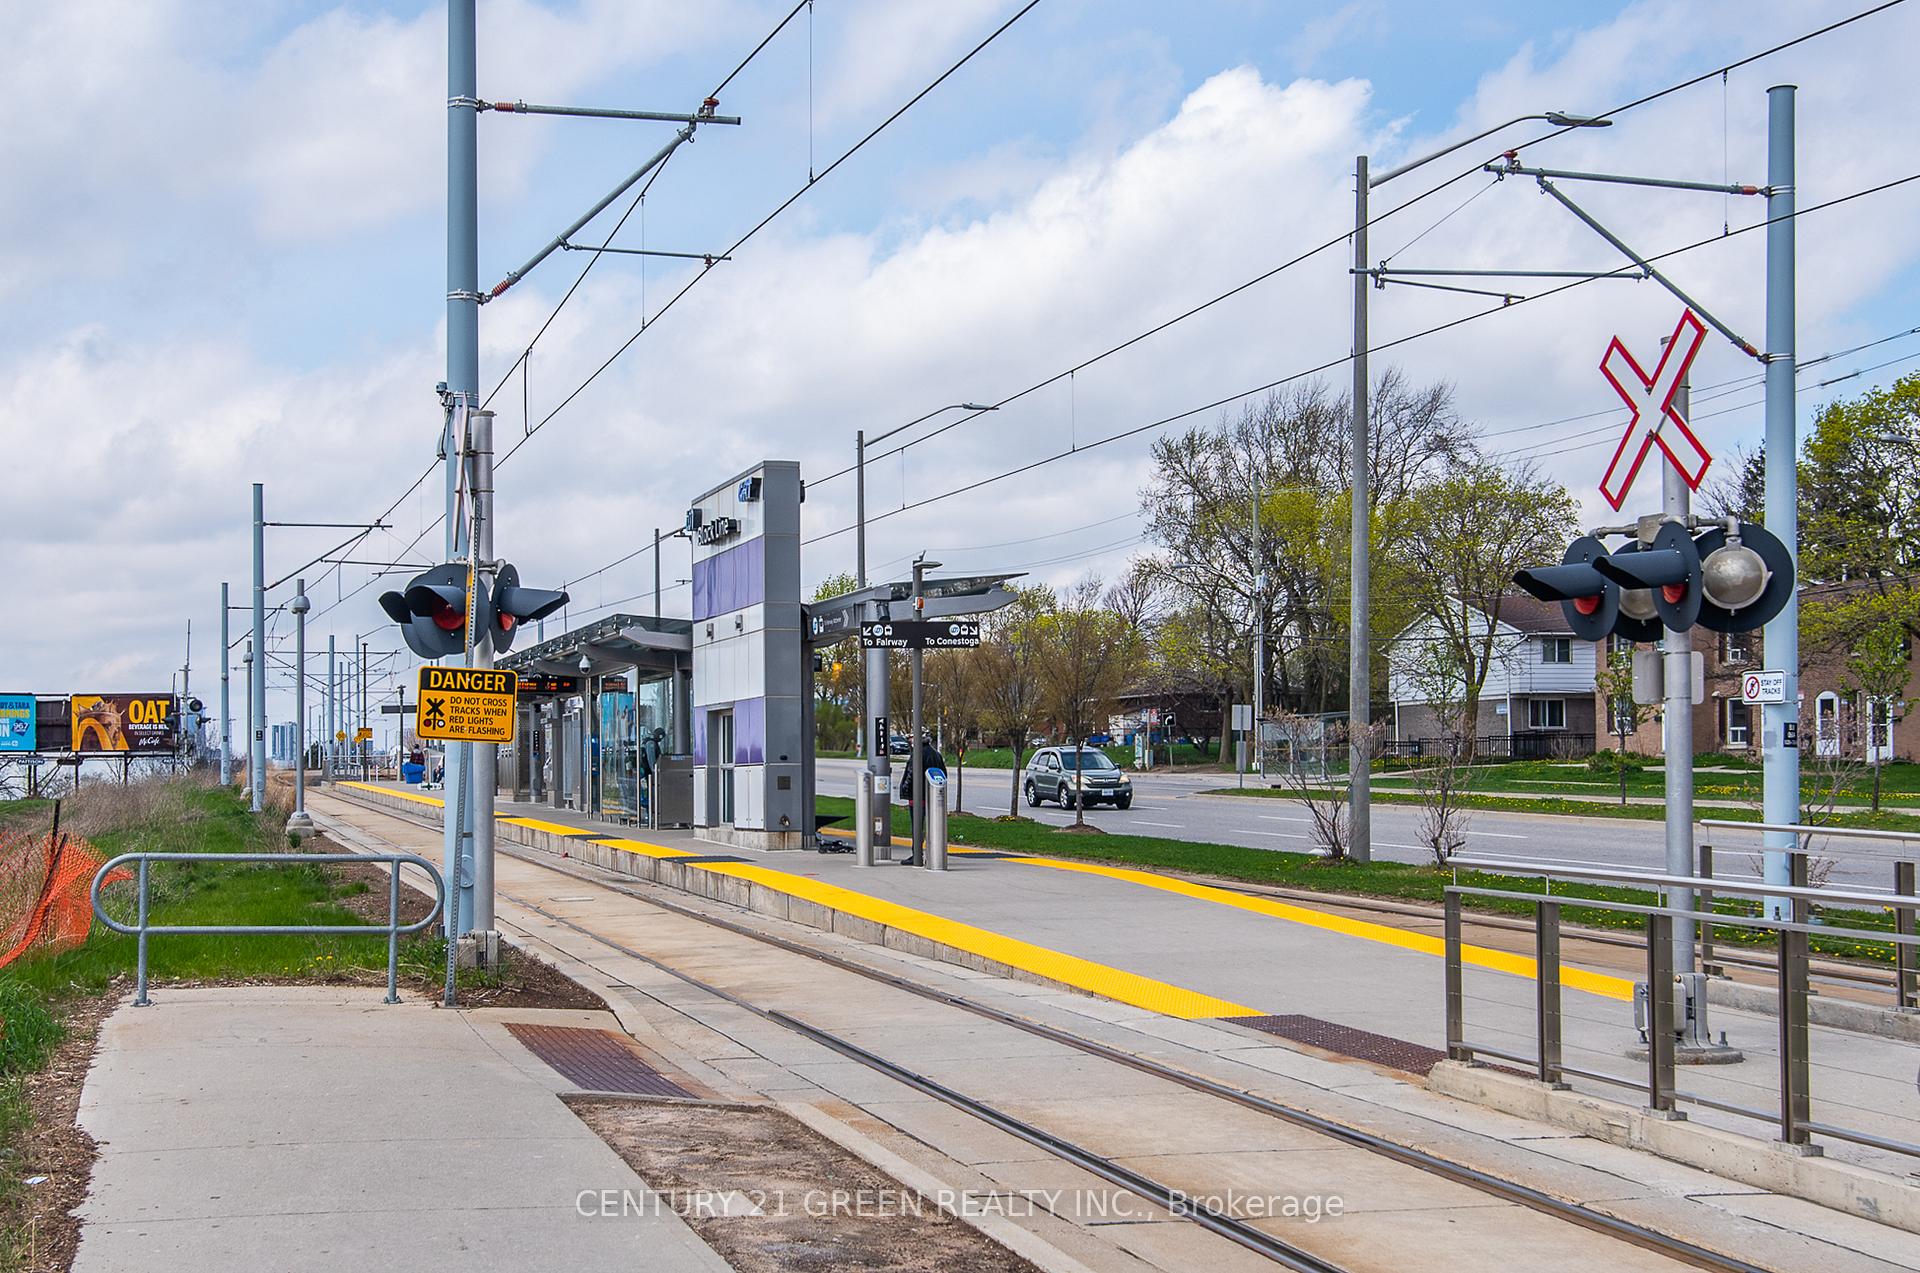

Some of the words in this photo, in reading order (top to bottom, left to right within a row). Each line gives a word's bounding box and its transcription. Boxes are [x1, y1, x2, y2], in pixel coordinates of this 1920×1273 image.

[876, 638, 908, 648] Fairway
[925, 637, 935, 646] To
[936, 637, 980, 647] Conestoga
[429, 670, 507, 692] DANGER
[1760, 679, 1772, 687] STAY
[1773, 678, 1783, 686] OFF
[1762, 687, 1781, 695] TRACKS
[450, 696, 462, 704] DO
[464, 697, 480, 706] NOT
[482, 698, 508, 707] CROSS
[128, 699, 170, 724] OAT
[450, 705, 481, 715] TRACKS
[484, 707, 508, 717] WHEN
[449, 715, 465, 724] RED
[467, 716, 494, 726] LIGHTS
[449, 725, 465, 734] ARE
[468, 727, 506, 736] FLASHING
